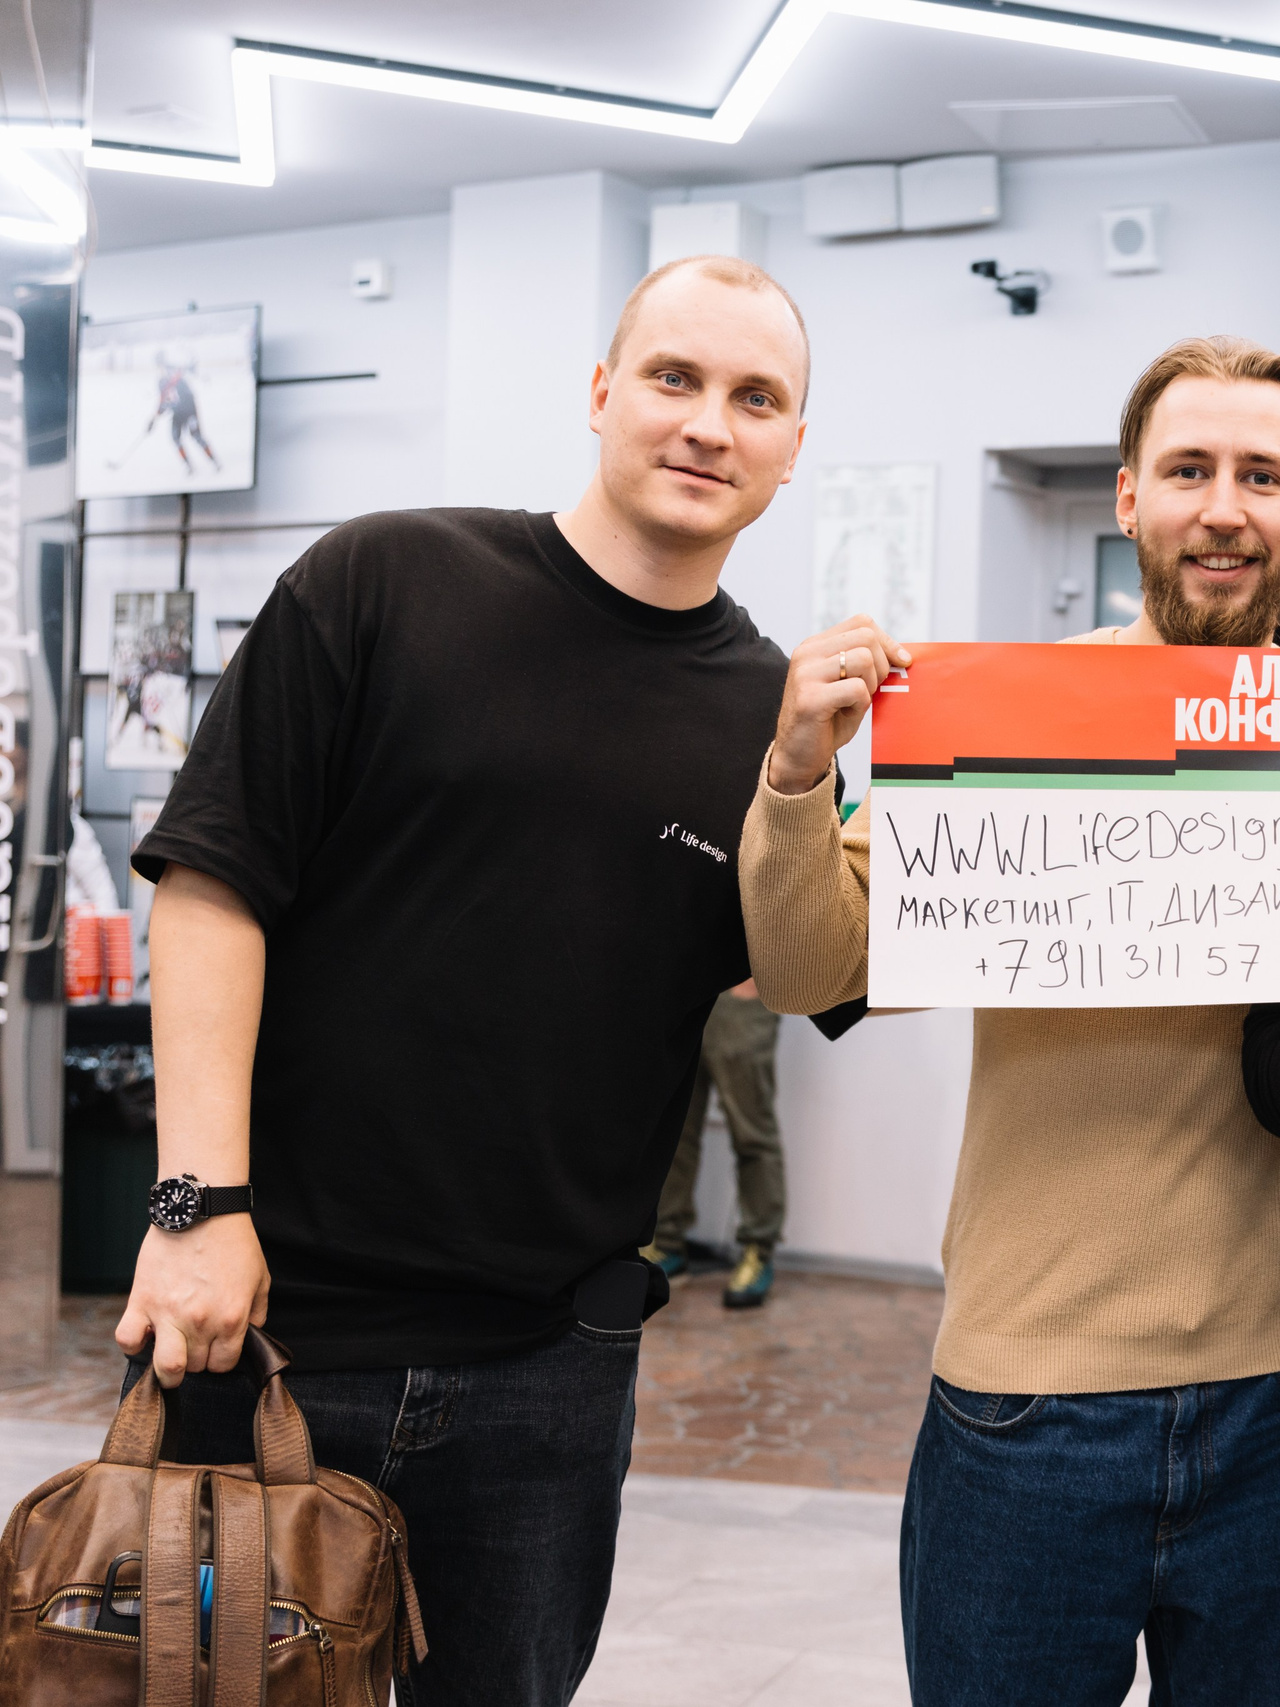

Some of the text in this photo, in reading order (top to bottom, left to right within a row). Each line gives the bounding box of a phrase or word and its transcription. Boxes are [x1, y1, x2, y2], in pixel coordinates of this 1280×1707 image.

[680, 829, 727, 862] Life design
[1207, 944, 1260, 982] 57
